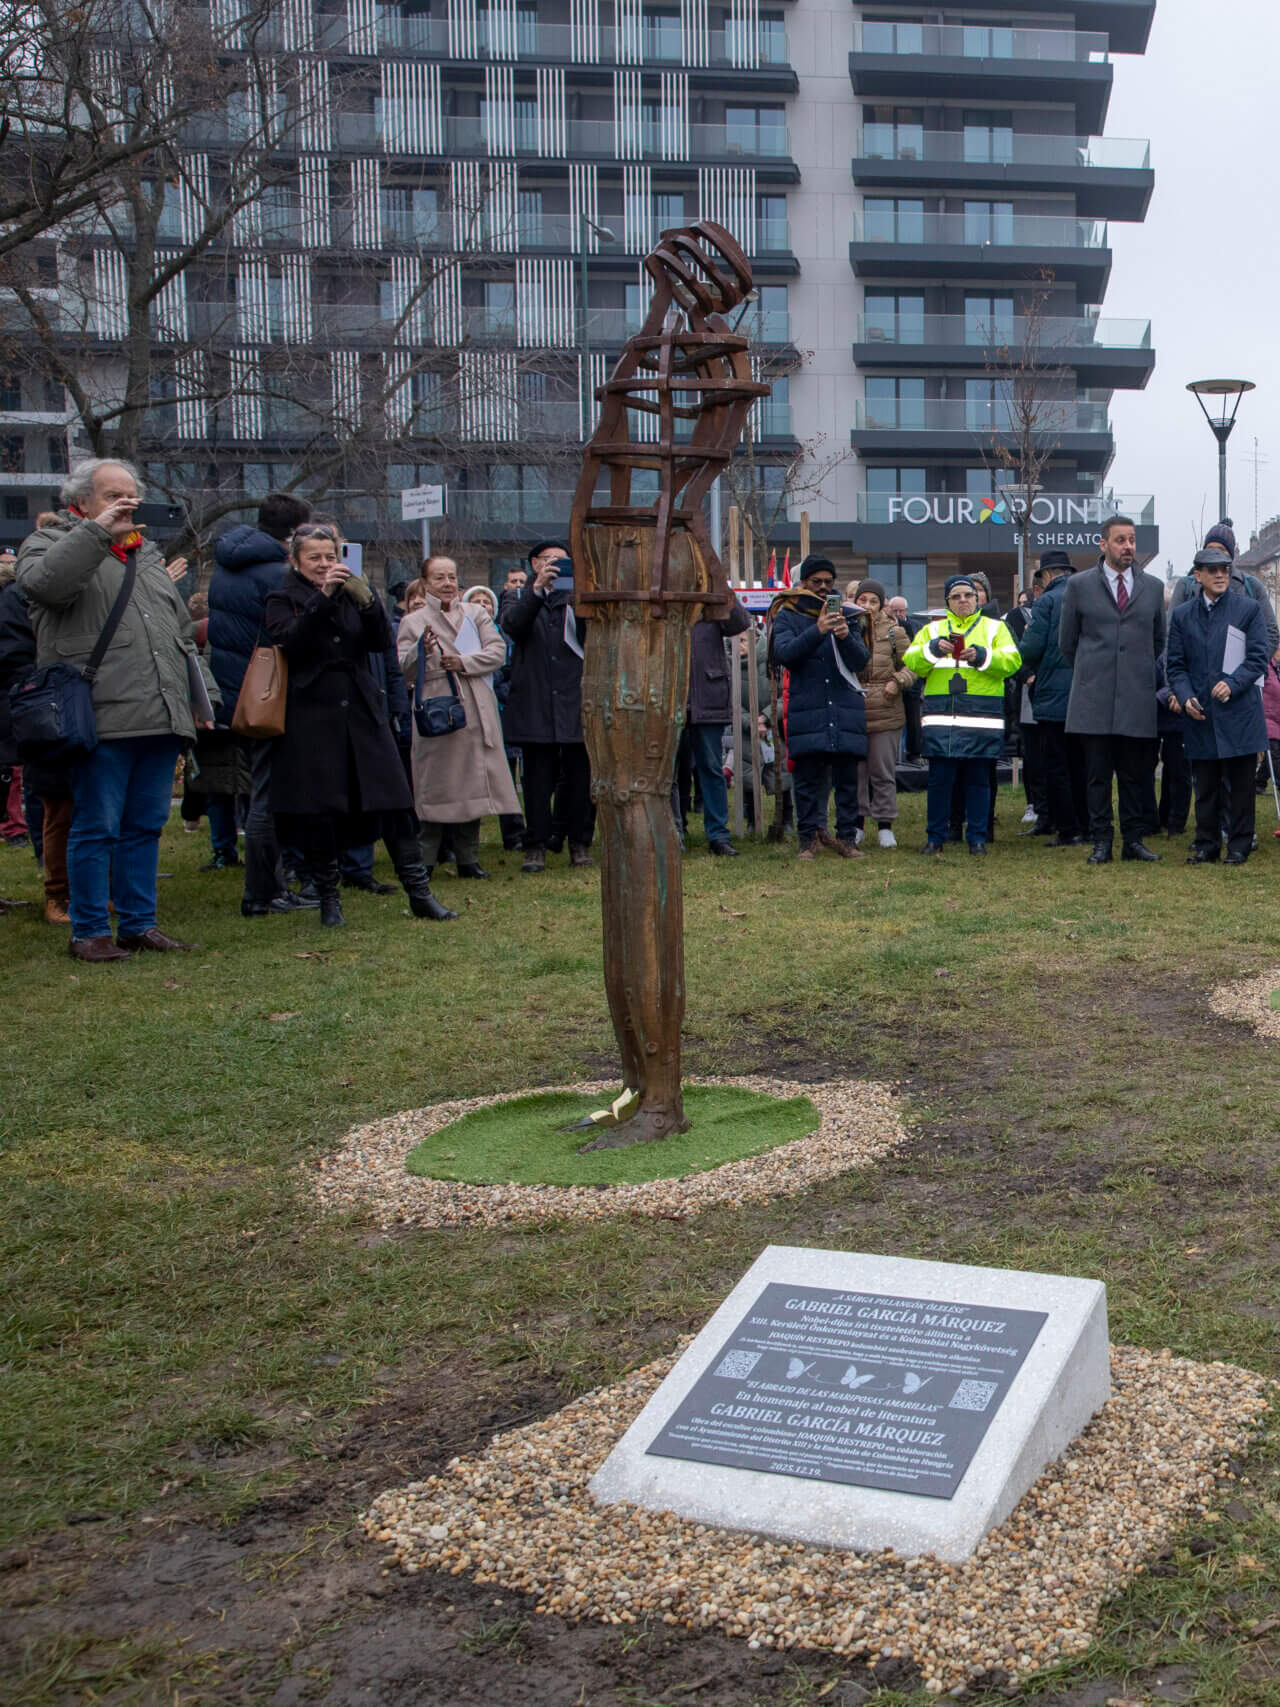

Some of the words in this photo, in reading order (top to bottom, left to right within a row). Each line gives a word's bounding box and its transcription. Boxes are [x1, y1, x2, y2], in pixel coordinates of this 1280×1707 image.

[889, 497, 976, 524] FOUR
[1037, 533, 1102, 544] SHERATO
[785, 1299, 853, 1316] GABRIEL
[857, 1307, 917, 1324] GARCÍA
[920, 1314, 1007, 1334] MÁRQUEZ
[768, 1331, 806, 1342] JOAQUÍN
[806, 1336, 850, 1347] RESTREPO
[736, 1391, 751, 1401] En
[752, 1393, 810, 1410] homenaje
[811, 1401, 825, 1411] al
[824, 1405, 860, 1416] nobel
[860, 1408, 876, 1418] de
[877, 1410, 936, 1426] literatura
[809, 1389, 830, 1398] LAS
[828, 1392, 884, 1405] MARIPOSAS
[710, 1403, 782, 1424] GABRIEL
[787, 1414, 851, 1433] GARCÍA
[853, 1422, 946, 1446] MÁRQUEZ
[796, 1431, 837, 1443] JOAQUÍN
[837, 1437, 886, 1450] RESTREPO
